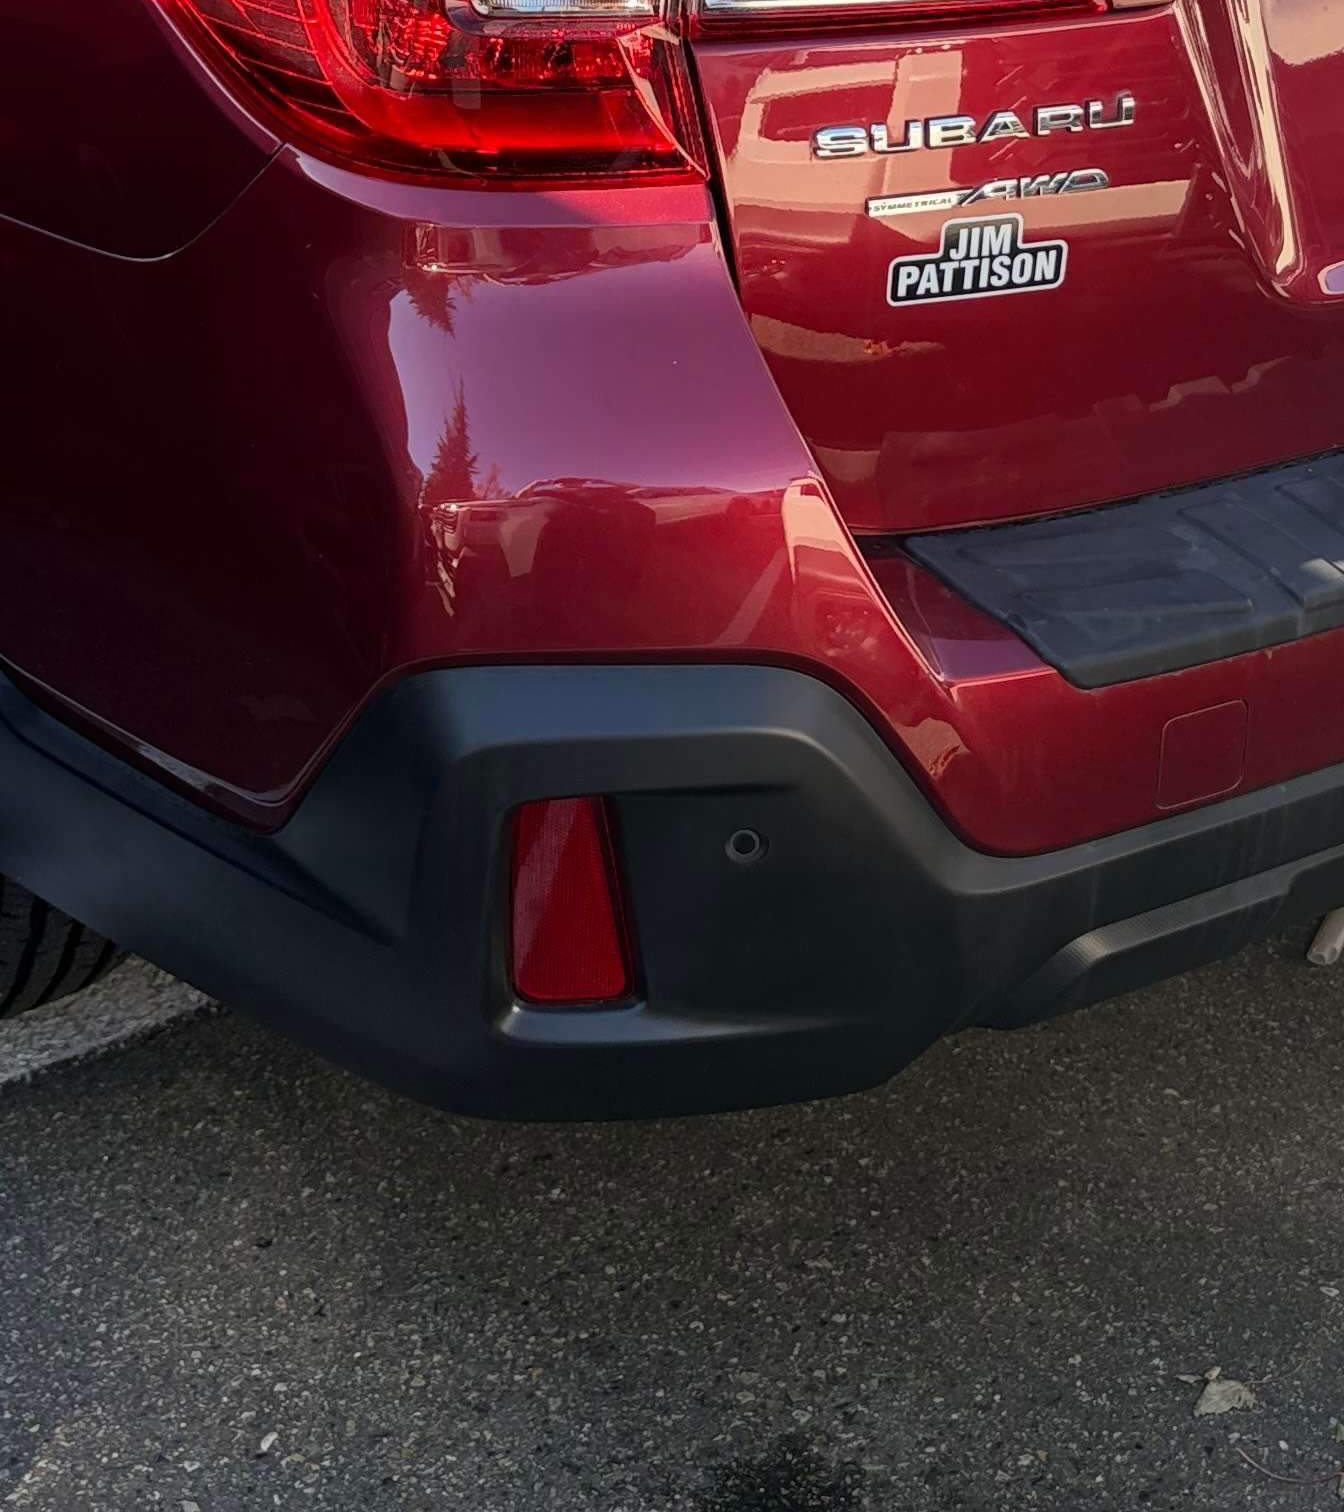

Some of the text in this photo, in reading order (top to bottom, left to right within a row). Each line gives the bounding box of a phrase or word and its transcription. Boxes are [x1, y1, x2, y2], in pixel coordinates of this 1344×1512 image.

[814, 95, 1136, 158] SUBARU
[872, 168, 1110, 213] SYMMETRICAL AWD
[950, 225, 1012, 260] JIM
[896, 250, 1057, 297] PATTISON
